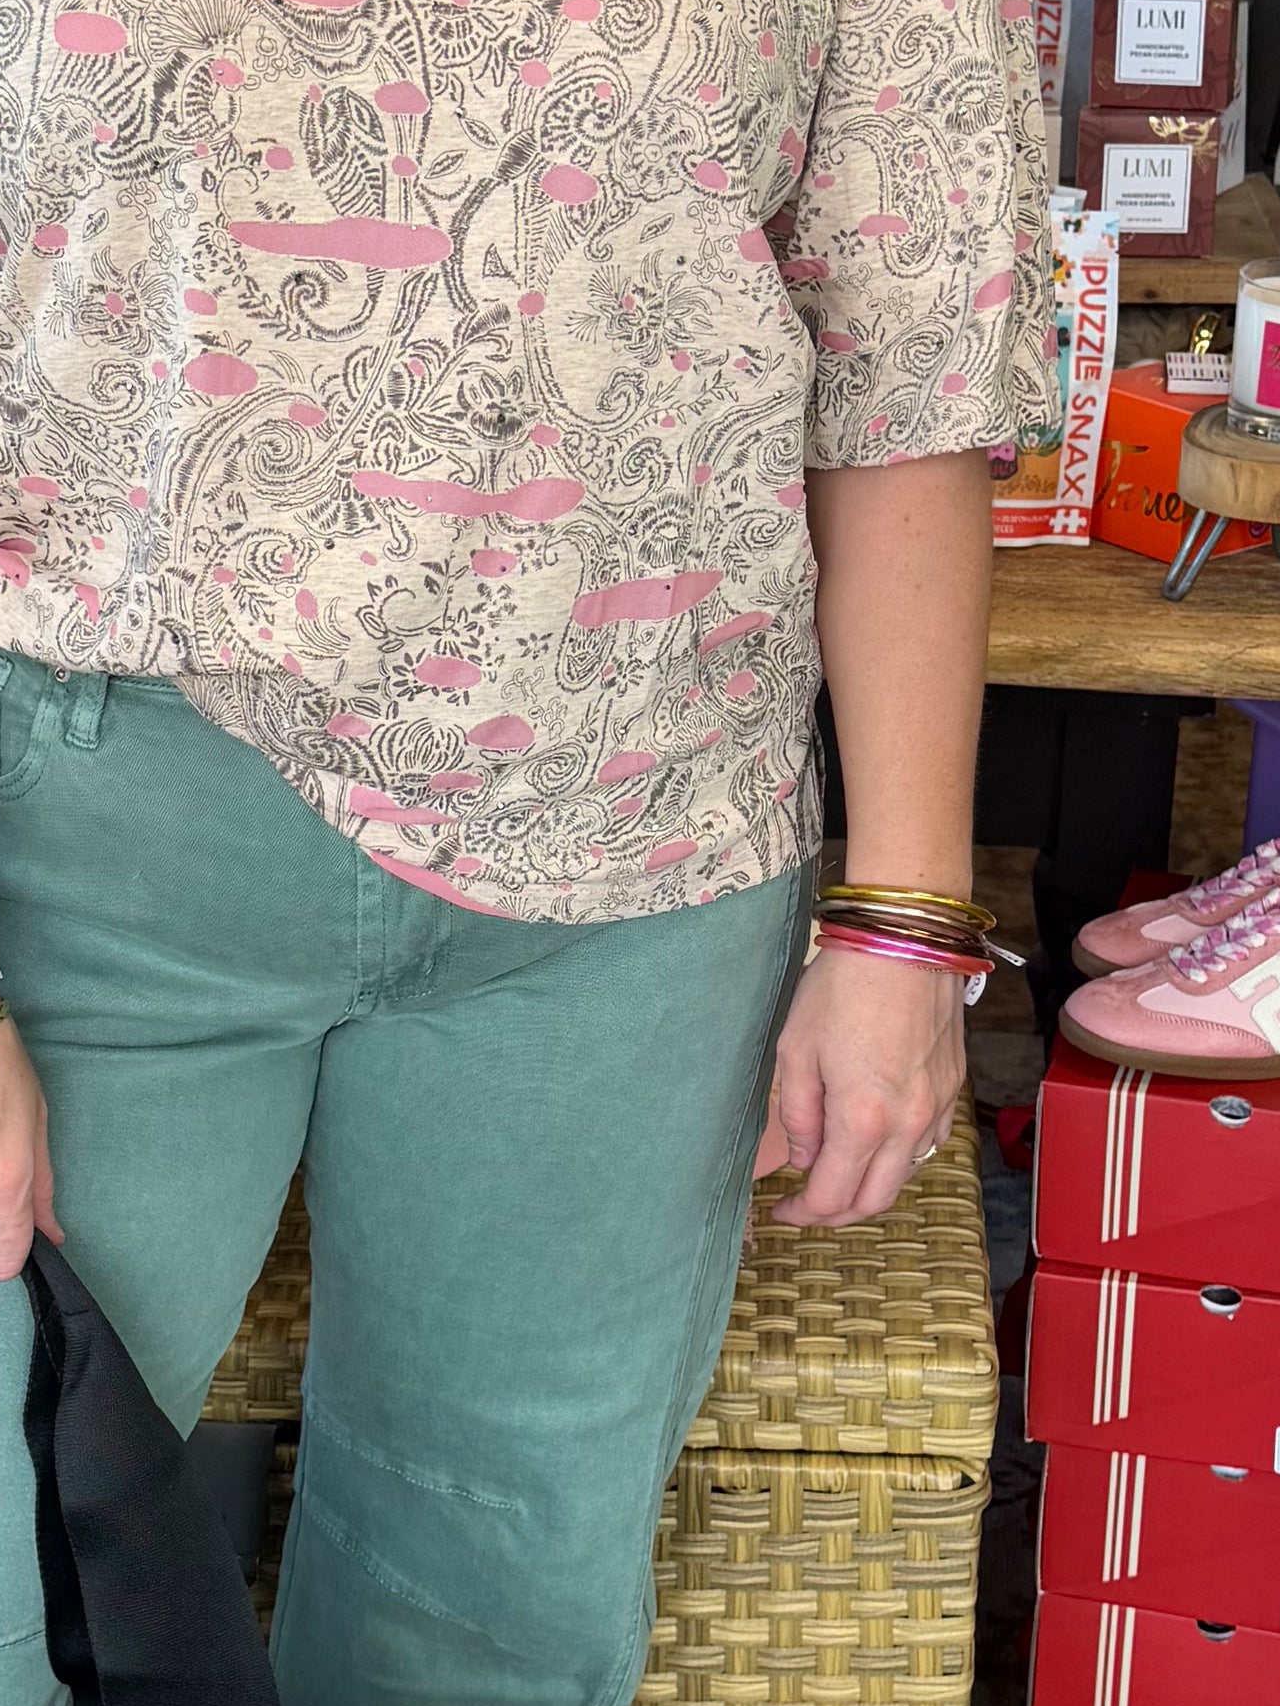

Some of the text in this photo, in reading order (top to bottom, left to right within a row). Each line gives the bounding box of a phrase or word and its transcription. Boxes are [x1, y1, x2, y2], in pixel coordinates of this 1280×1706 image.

[1136, 7, 1186, 30] LUMI
[1123, 157, 1172, 178] LUMI
[1059, 264, 1109, 501] PUZZLE SNAX
